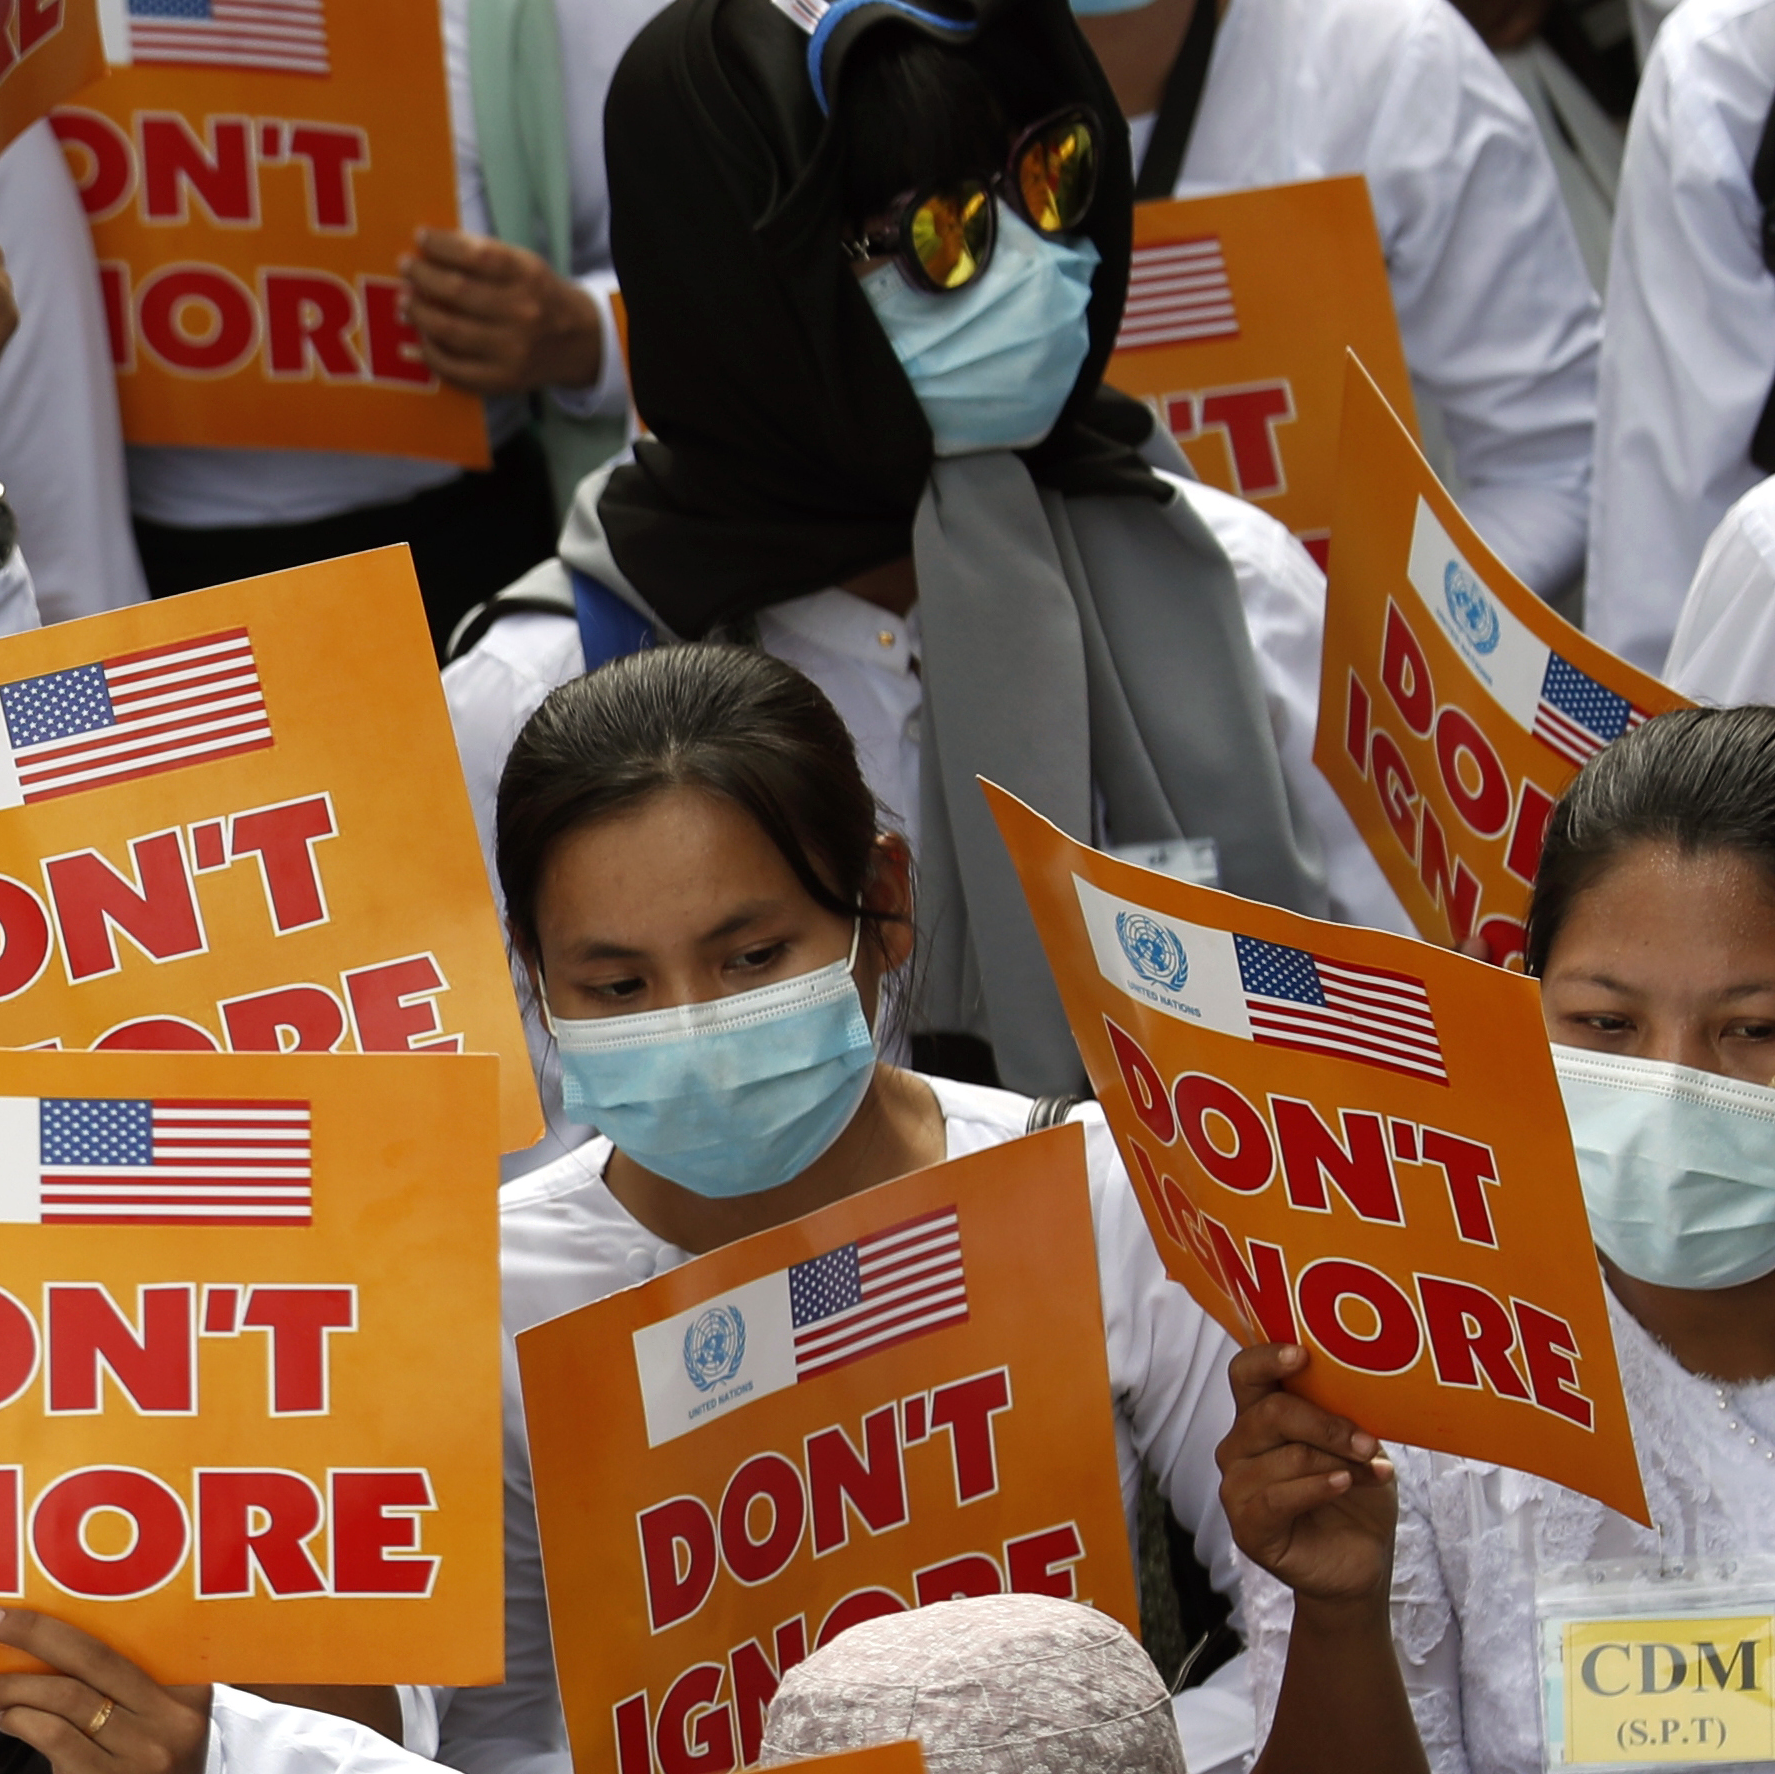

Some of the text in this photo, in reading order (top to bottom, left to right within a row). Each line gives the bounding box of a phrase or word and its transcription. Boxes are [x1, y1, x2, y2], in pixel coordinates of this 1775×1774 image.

[49, 105, 371, 235] ON'T
[1127, 980, 1202, 1018] UNITED NATIONS
[1103, 1013, 1500, 1249] DON'T
[1127, 1133, 1596, 1432] IGNORE
[688, 1380, 754, 1420] UNITED NATIONS
[636, 1365, 1013, 1635] DON'T
[1581, 1639, 1762, 1697] CDM
[1617, 1716, 1727, 1752] (S.P.T)
